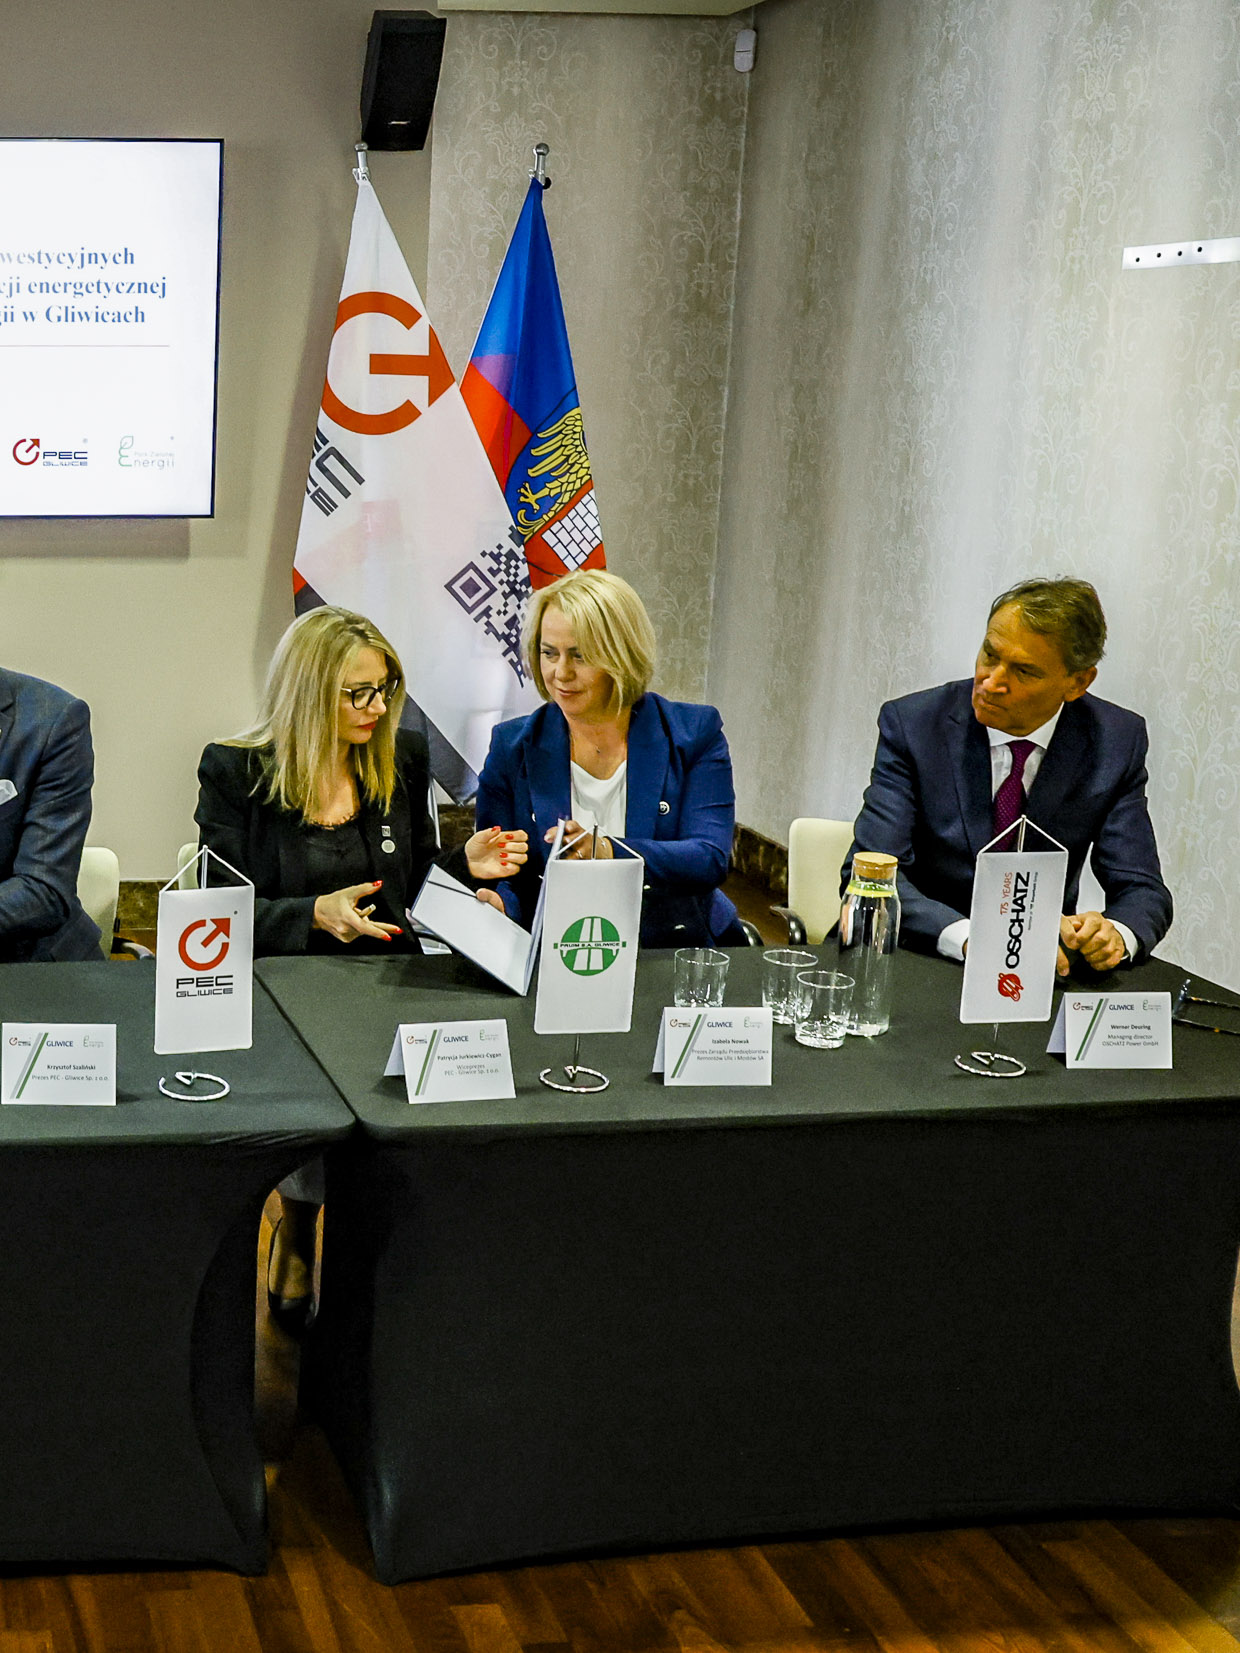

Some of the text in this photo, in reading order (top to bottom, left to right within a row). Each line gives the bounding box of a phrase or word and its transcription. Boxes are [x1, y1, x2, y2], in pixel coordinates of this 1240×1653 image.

[27, 277, 168, 299] energetycznej
[22, 311, 38, 324] w
[44, 304, 146, 324] Gliwicach
[42, 451, 88, 460] PEC
[1002, 871, 1014, 899] YEARS
[1005, 871, 1031, 969] OSCHATZ
[176, 974, 234, 989] PEC
[176, 987, 234, 998] GLIWICE
